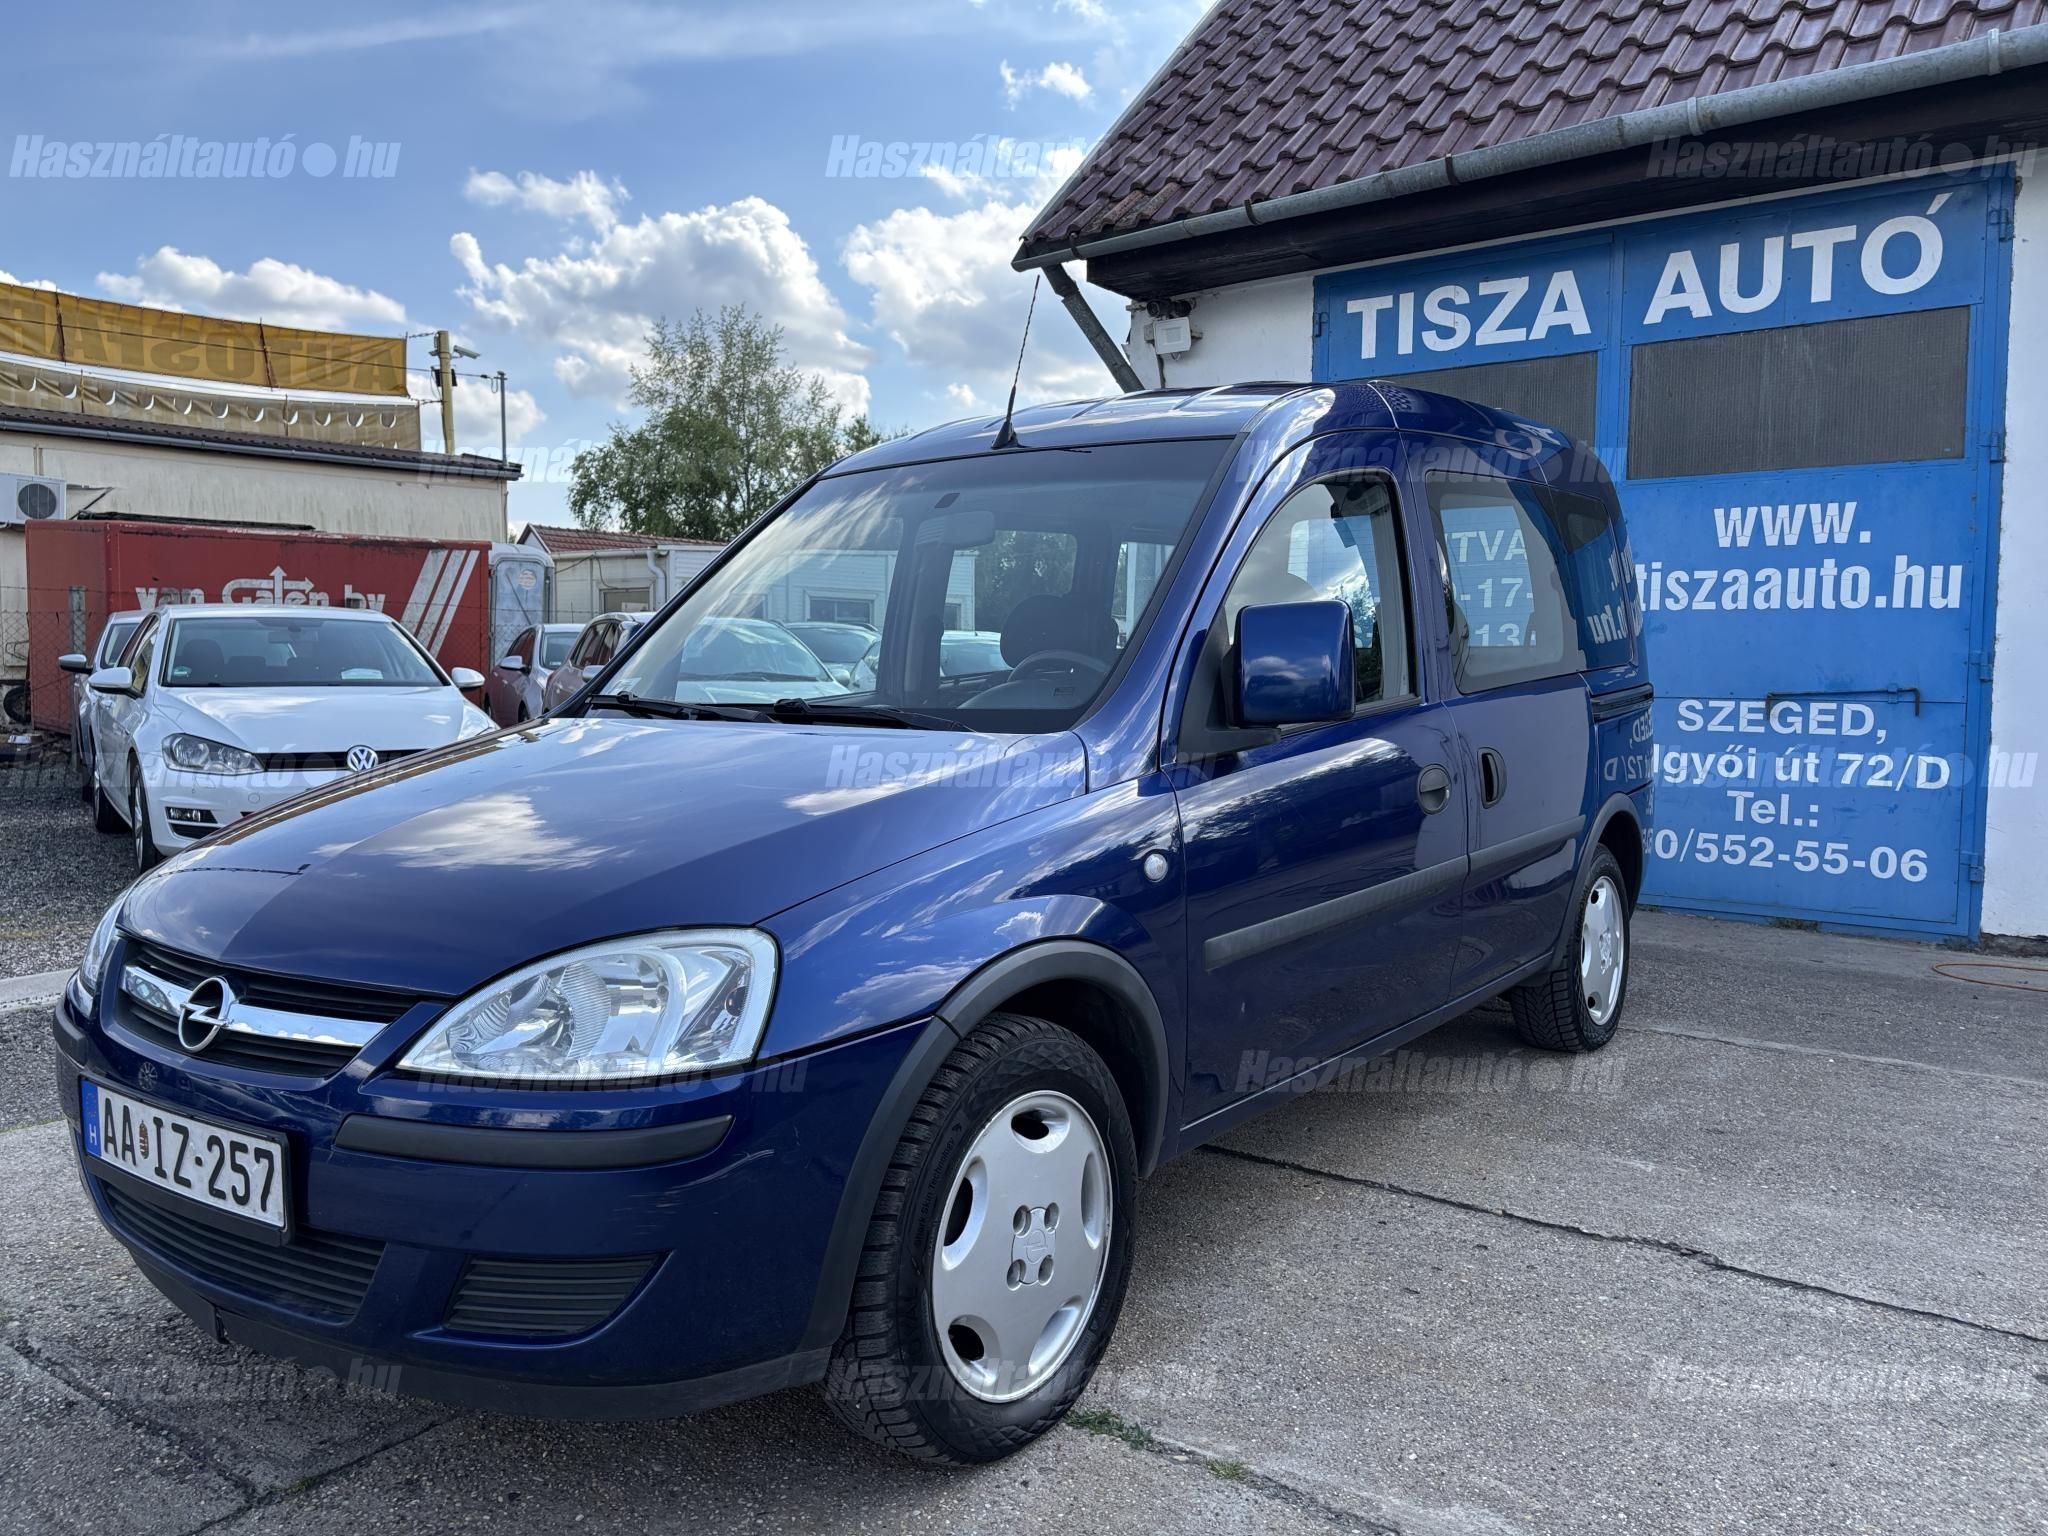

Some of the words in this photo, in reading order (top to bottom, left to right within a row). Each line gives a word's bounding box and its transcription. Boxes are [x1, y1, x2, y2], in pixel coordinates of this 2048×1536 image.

[1346, 270, 1592, 359] TISZA
[1643, 192, 1953, 325] AUTÓ
[1446, 529, 1528, 563] TVA
[1714, 502, 1871, 547] www.
[1635, 555, 1963, 611] tiszaauto.hu
[1677, 700, 1887, 743] SZEGED,
[1775, 745, 1820, 784] út
[1837, 750, 1950, 792] 72/D
[1727, 790, 1819, 827] Tel.:
[89, 1124, 98, 1146] H
[104, 1097, 137, 1167] AA
